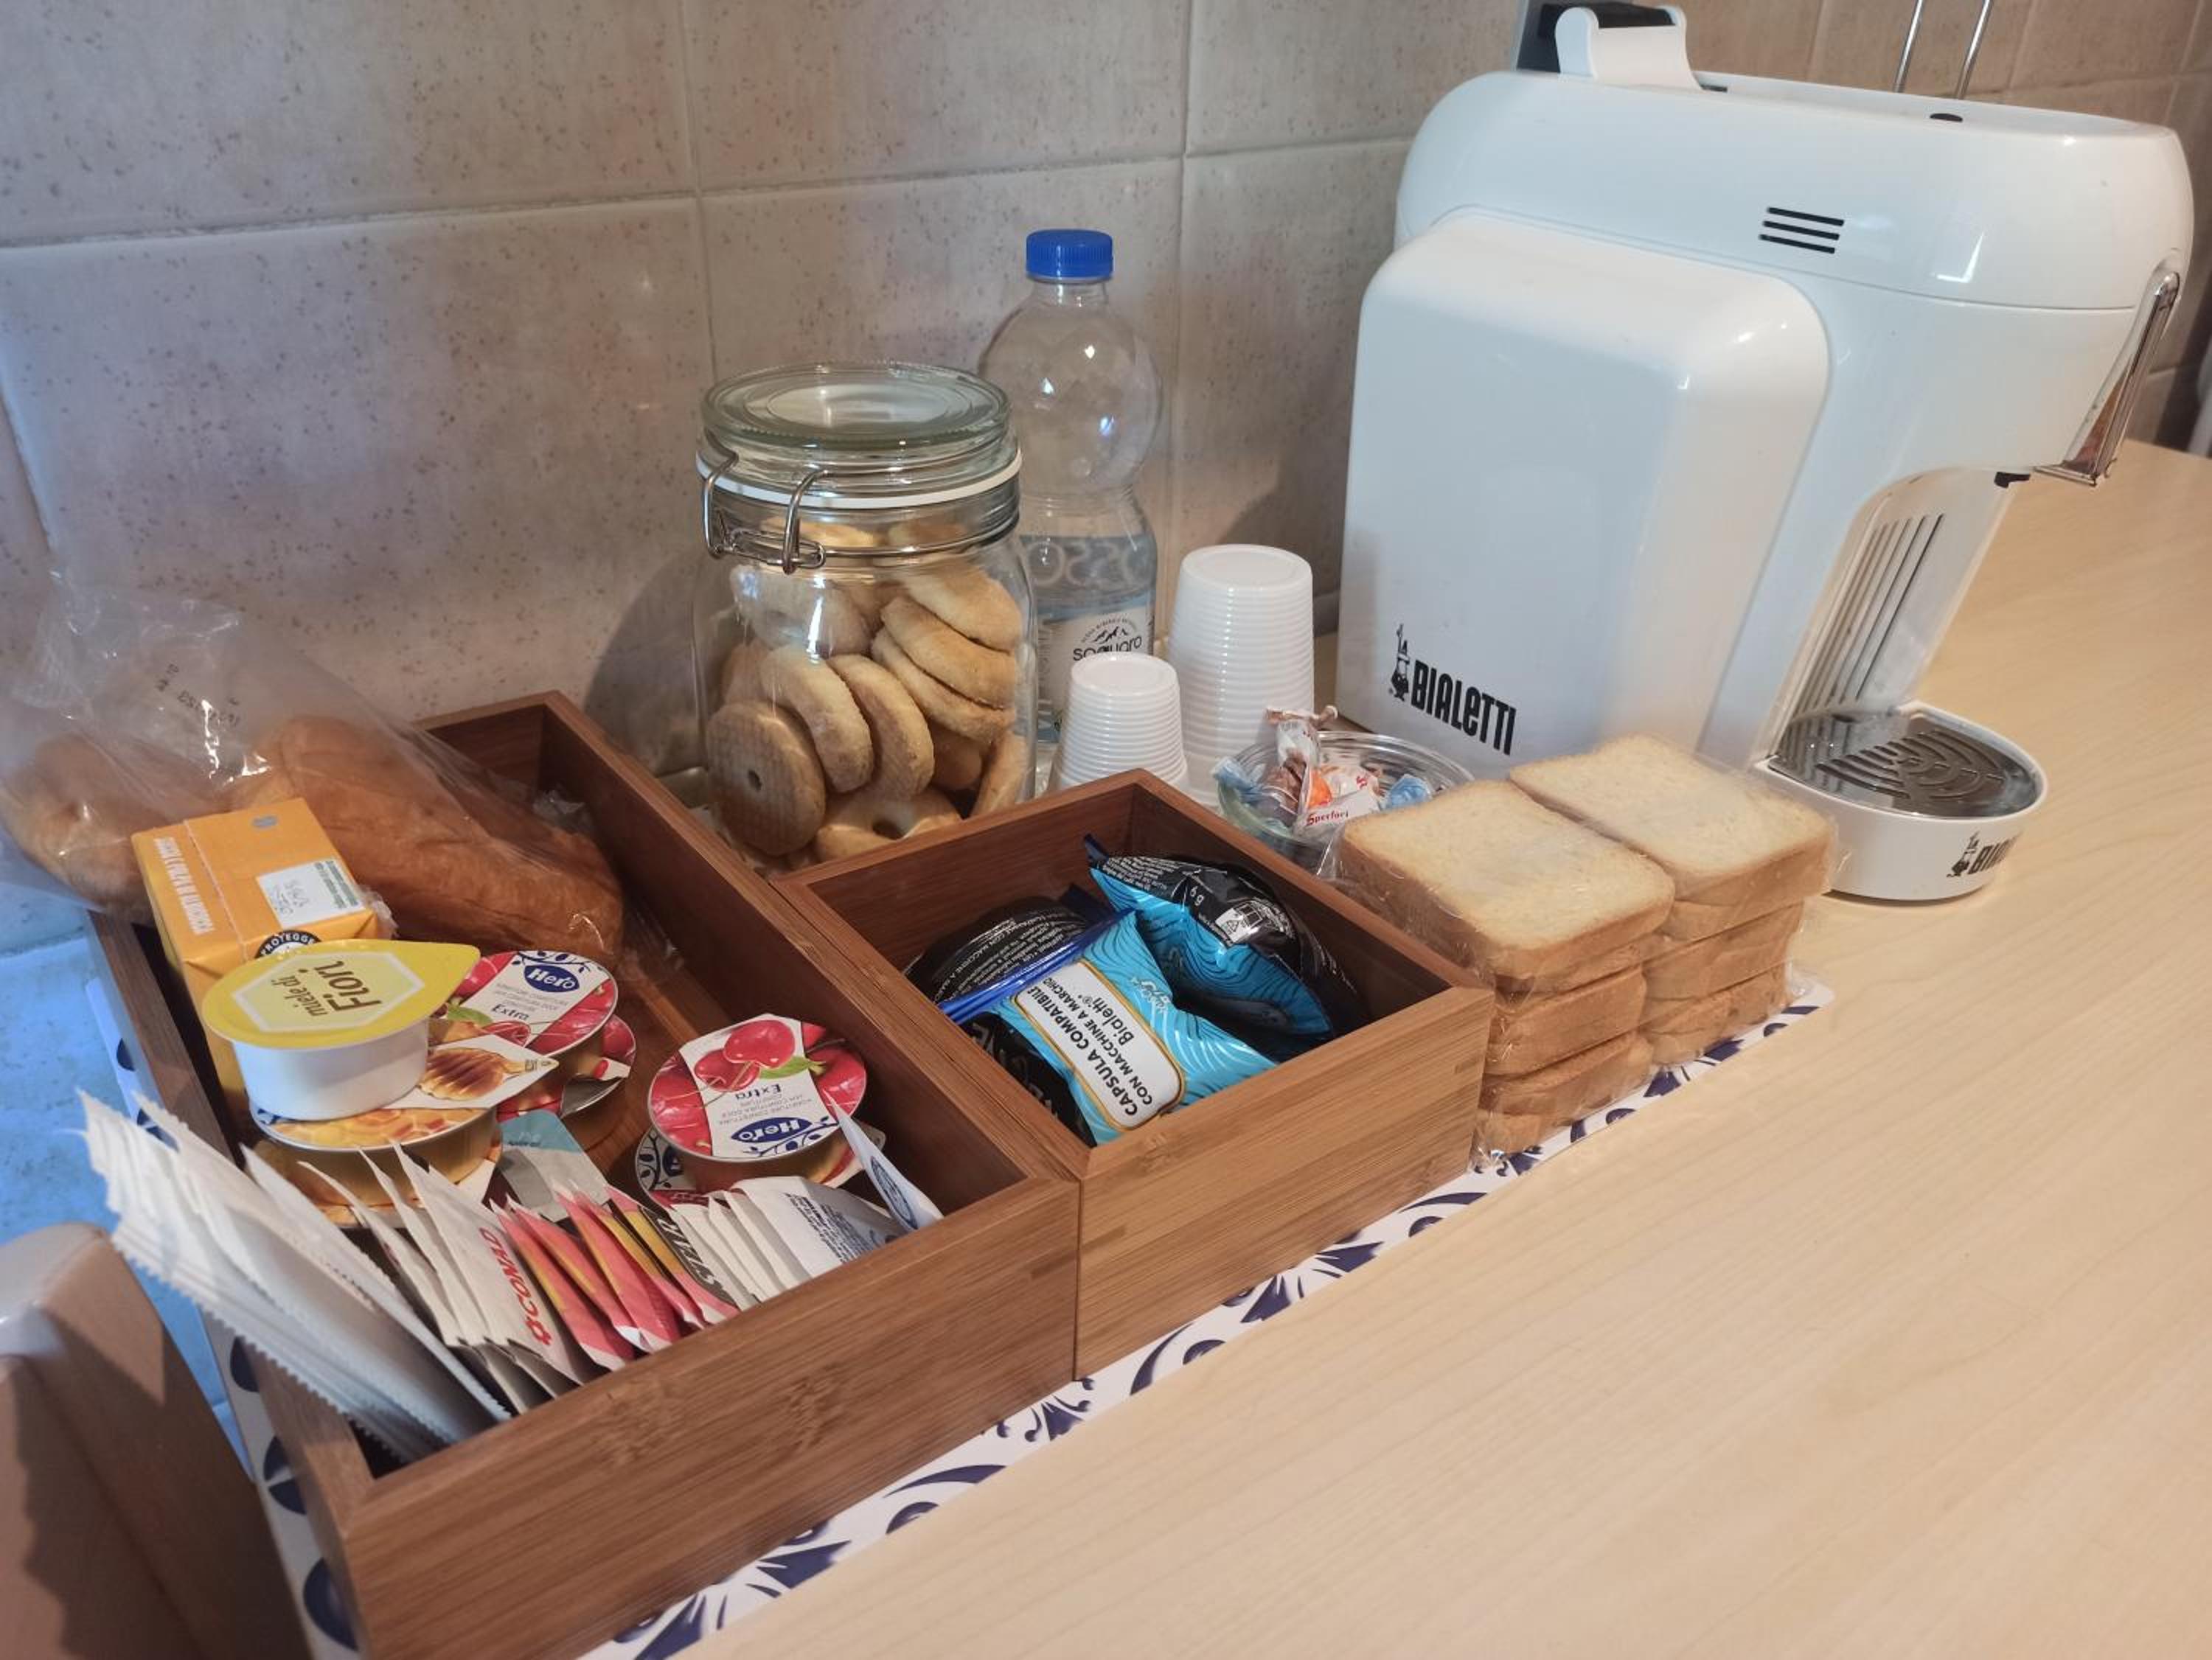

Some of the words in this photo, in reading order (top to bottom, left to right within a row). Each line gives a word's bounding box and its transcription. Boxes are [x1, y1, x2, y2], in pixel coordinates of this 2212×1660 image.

[1411, 659, 1517, 756] BIALETTI
[1190, 885, 1198, 897] 6
[1194, 894, 1204, 906] g
[271, 974, 302, 987] di
[298, 960, 383, 1011] Fiori
[526, 968, 576, 989] Hero
[285, 987, 328, 1016] miele
[491, 1003, 530, 1022] Extra
[1077, 1010, 1089, 1020] A
[1084, 1019, 1134, 1076] MACCHINE
[735, 1084, 782, 1100] Extra
[1088, 1049, 1138, 1116] CAPSULA
[1129, 1075, 1153, 1106] CON
[738, 1119, 801, 1141] Hero
[479, 1227, 539, 1317] CONAD
